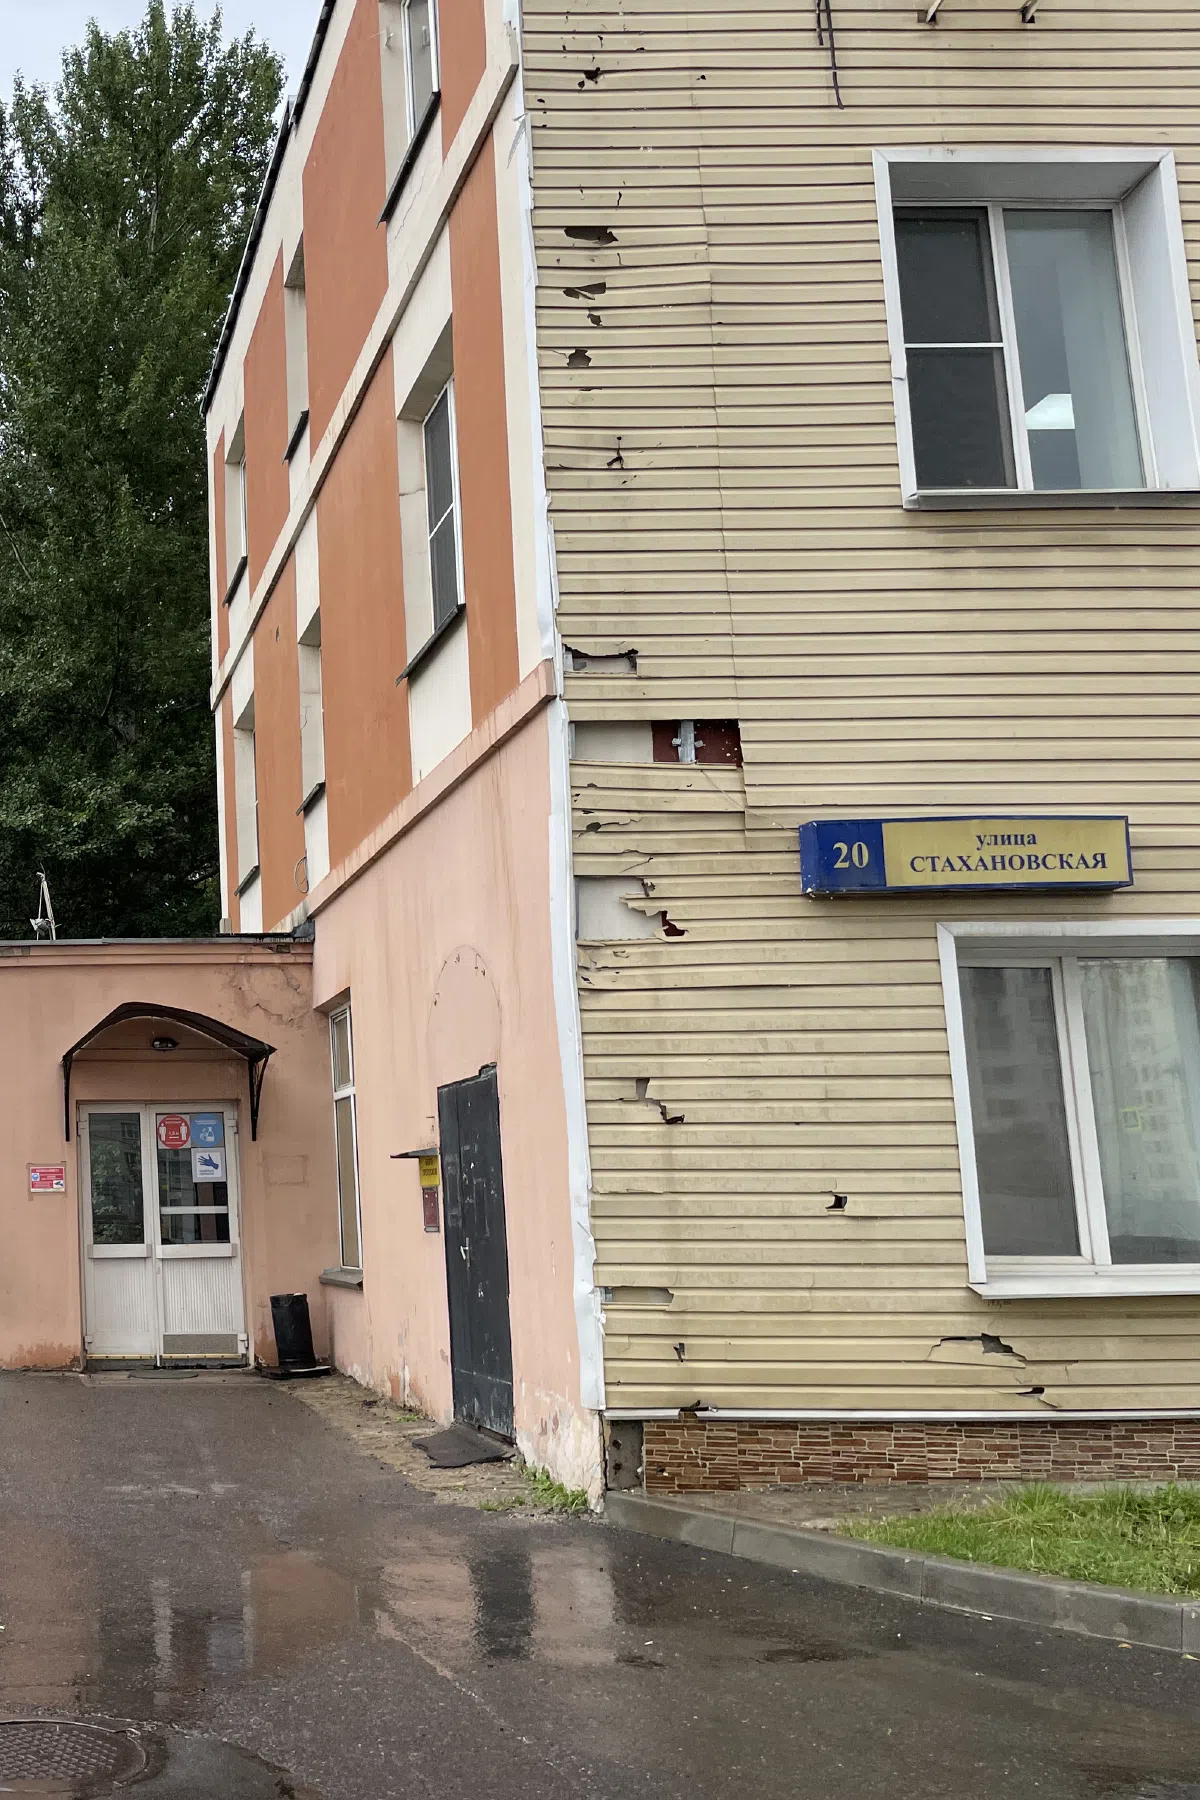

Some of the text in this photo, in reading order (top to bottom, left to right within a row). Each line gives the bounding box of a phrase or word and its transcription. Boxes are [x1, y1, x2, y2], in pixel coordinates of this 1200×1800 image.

[976, 832, 1037, 850] улица
[832, 841, 869, 869] 20
[909, 852, 1108, 874] СТАХАНОВСКАЯ
